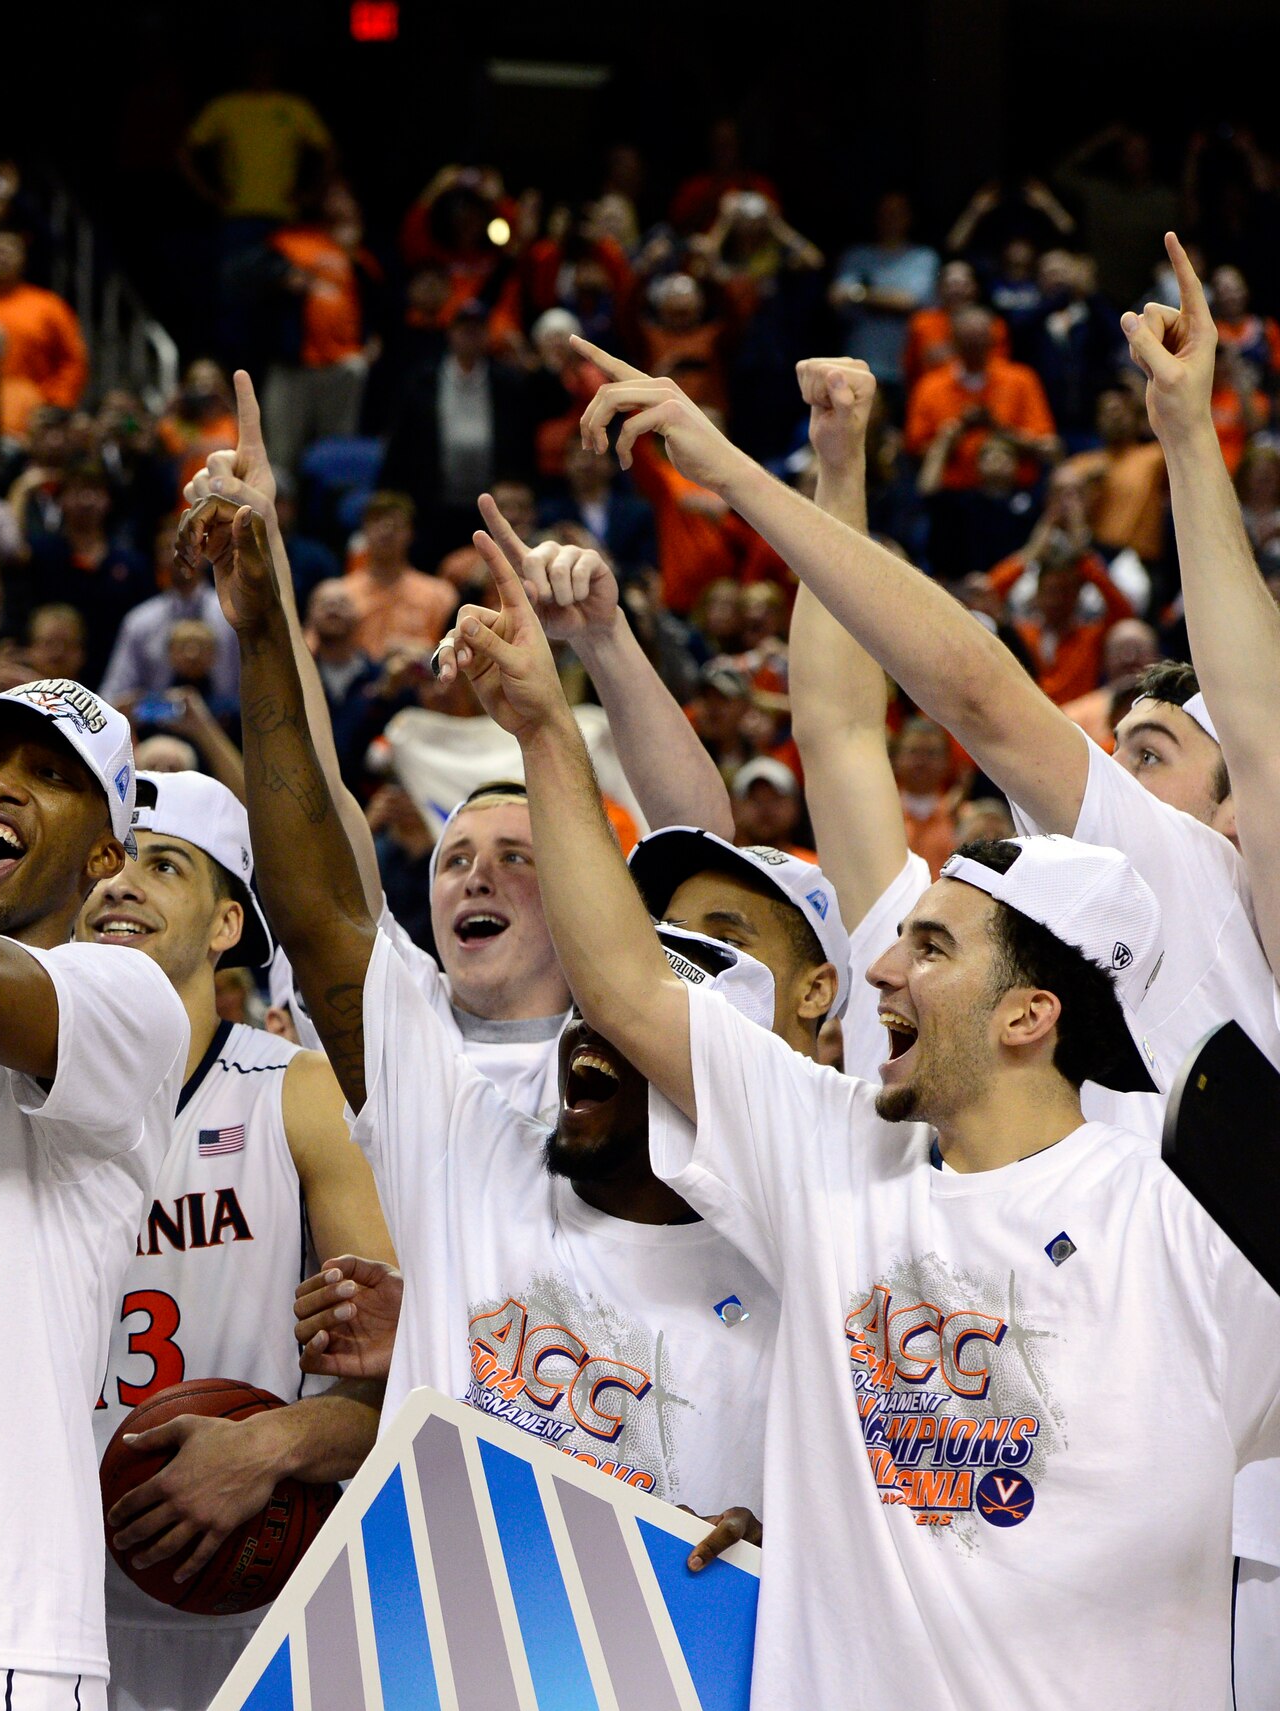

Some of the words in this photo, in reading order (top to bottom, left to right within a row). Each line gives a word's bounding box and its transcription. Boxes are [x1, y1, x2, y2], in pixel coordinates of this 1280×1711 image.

[467, 1297, 653, 1443] ACC
[470, 1342, 528, 1402] 2014
[845, 1284, 1008, 1401] ACC
[465, 1381, 576, 1442] TOURNAMENT
